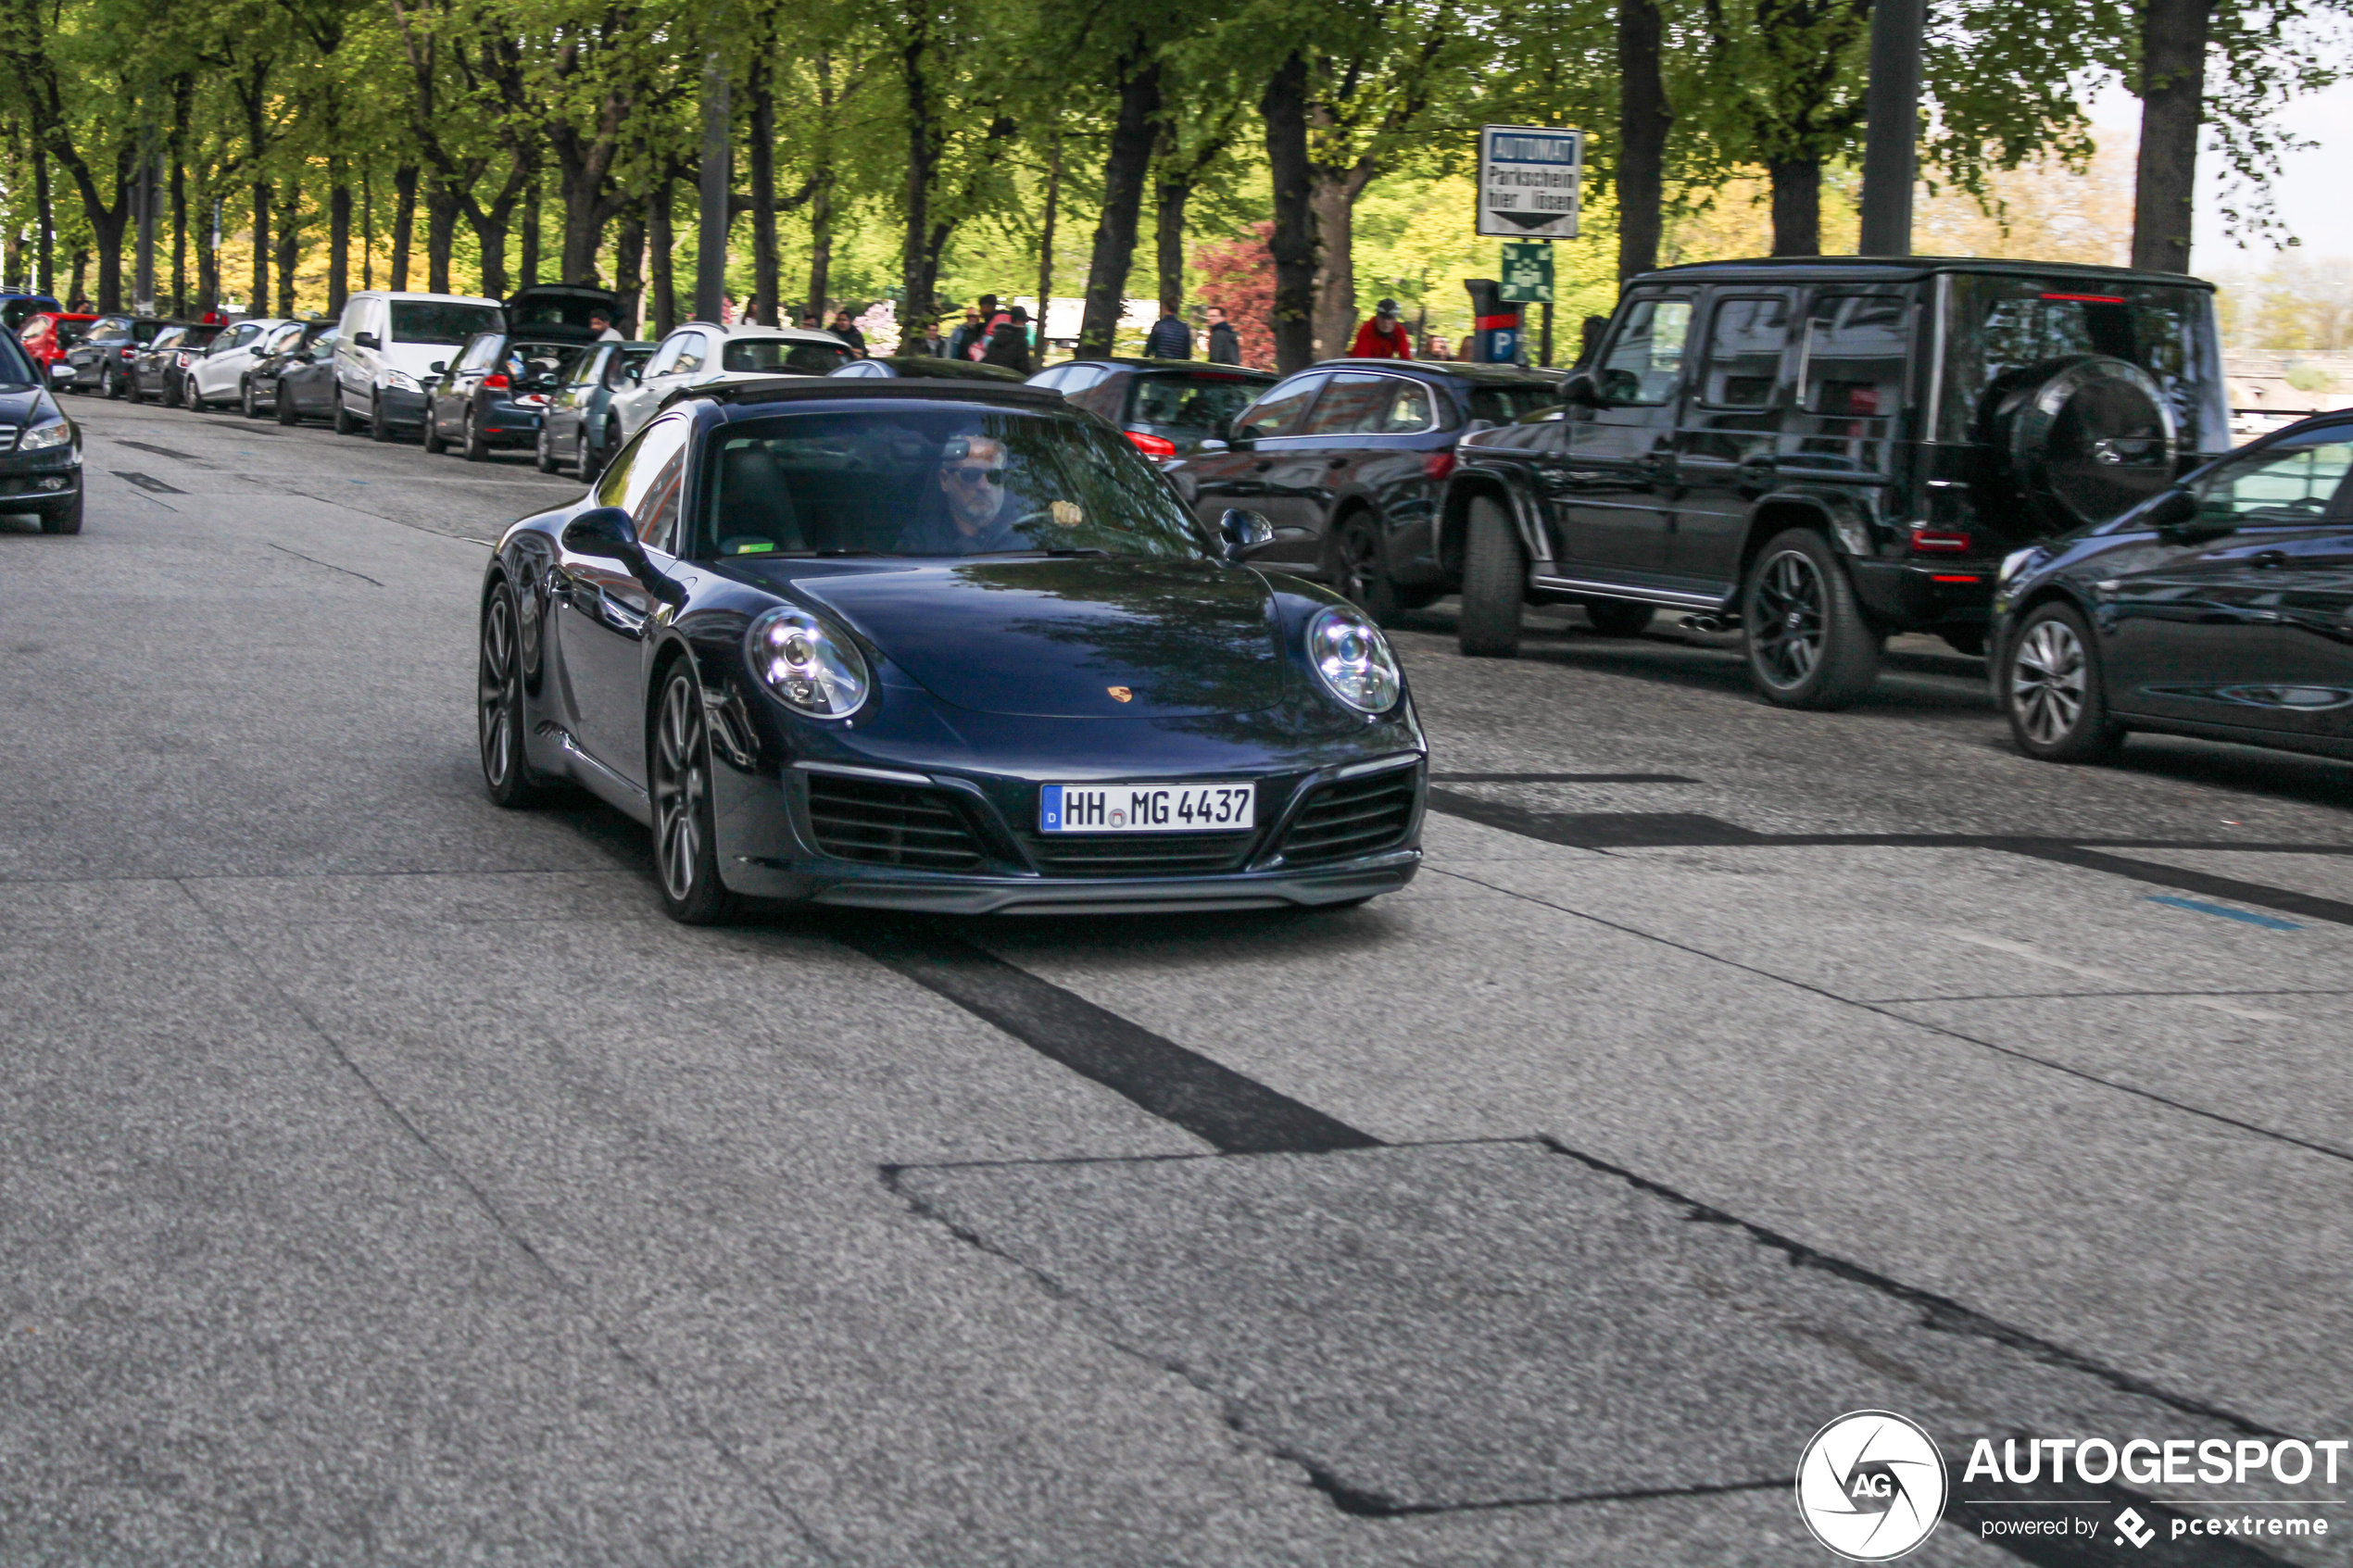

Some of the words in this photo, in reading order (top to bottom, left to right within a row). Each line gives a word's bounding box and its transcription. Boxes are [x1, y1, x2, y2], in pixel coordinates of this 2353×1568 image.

[1488, 165, 1574, 188] Parkschein
[1488, 188, 1519, 208] hier
[1531, 190, 1573, 211] lösen
[1494, 332, 1512, 355] P
[1048, 812, 1057, 823] D
[1065, 791, 1106, 825] HH
[1131, 790, 1170, 825] MG
[1177, 788, 1251, 824] 4437
